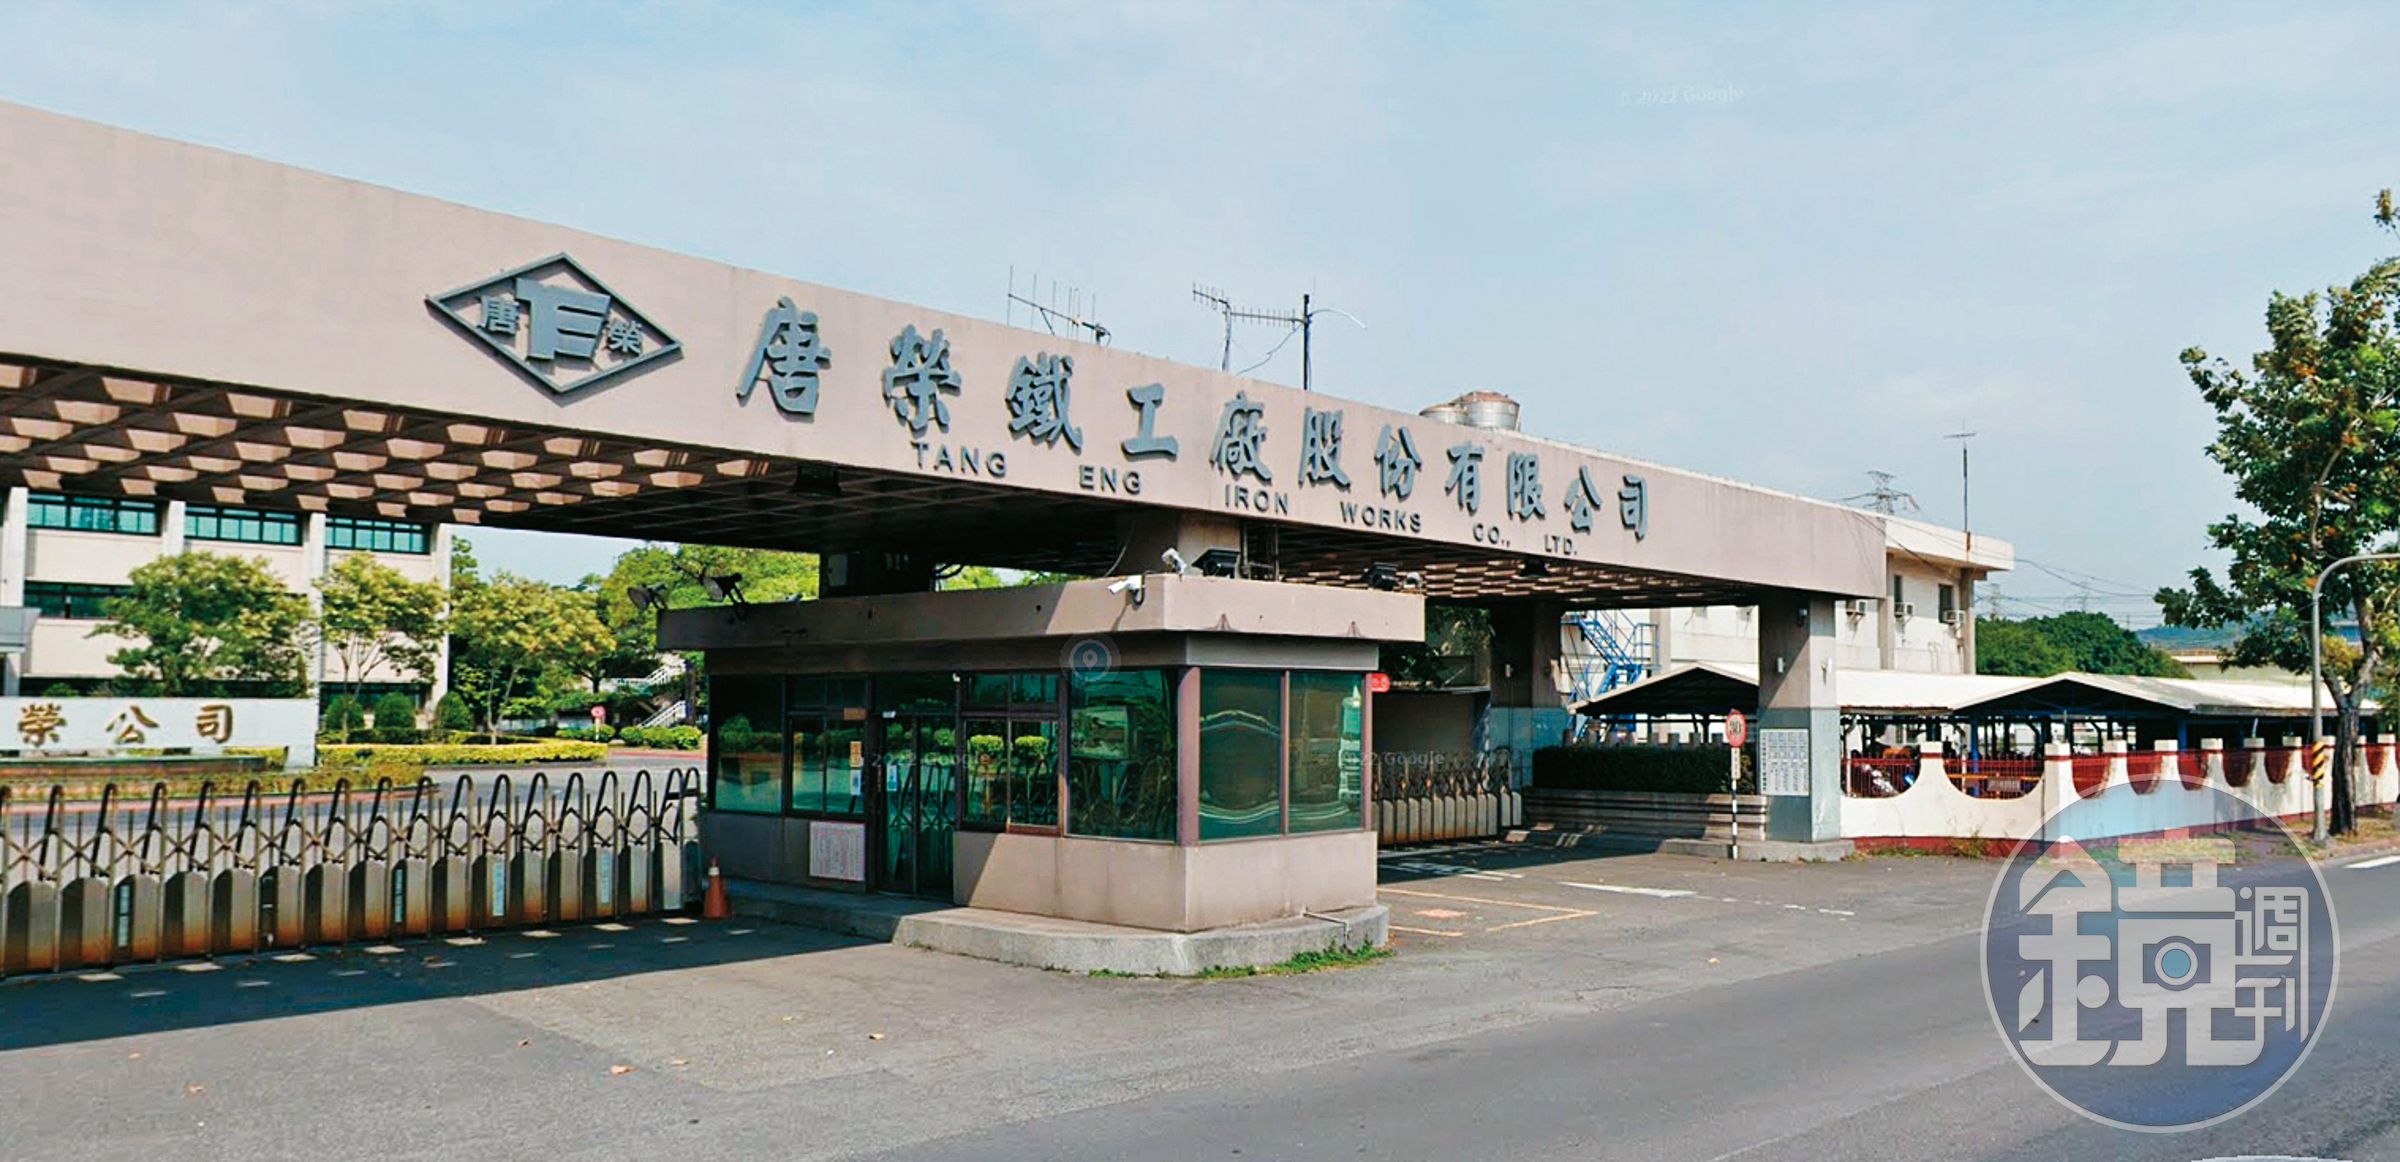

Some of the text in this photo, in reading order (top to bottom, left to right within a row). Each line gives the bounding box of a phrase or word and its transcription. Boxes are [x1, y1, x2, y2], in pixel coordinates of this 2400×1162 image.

[735, 296, 1649, 541] 唐榮鐵工廠股份有限公司
[911, 440, 1007, 478] TANG
[1079, 464, 1143, 495] ENG
[1224, 483, 1289, 516] IRON
[1340, 501, 1422, 534] WORKS
[18, 702, 233, 746] 榮公司
